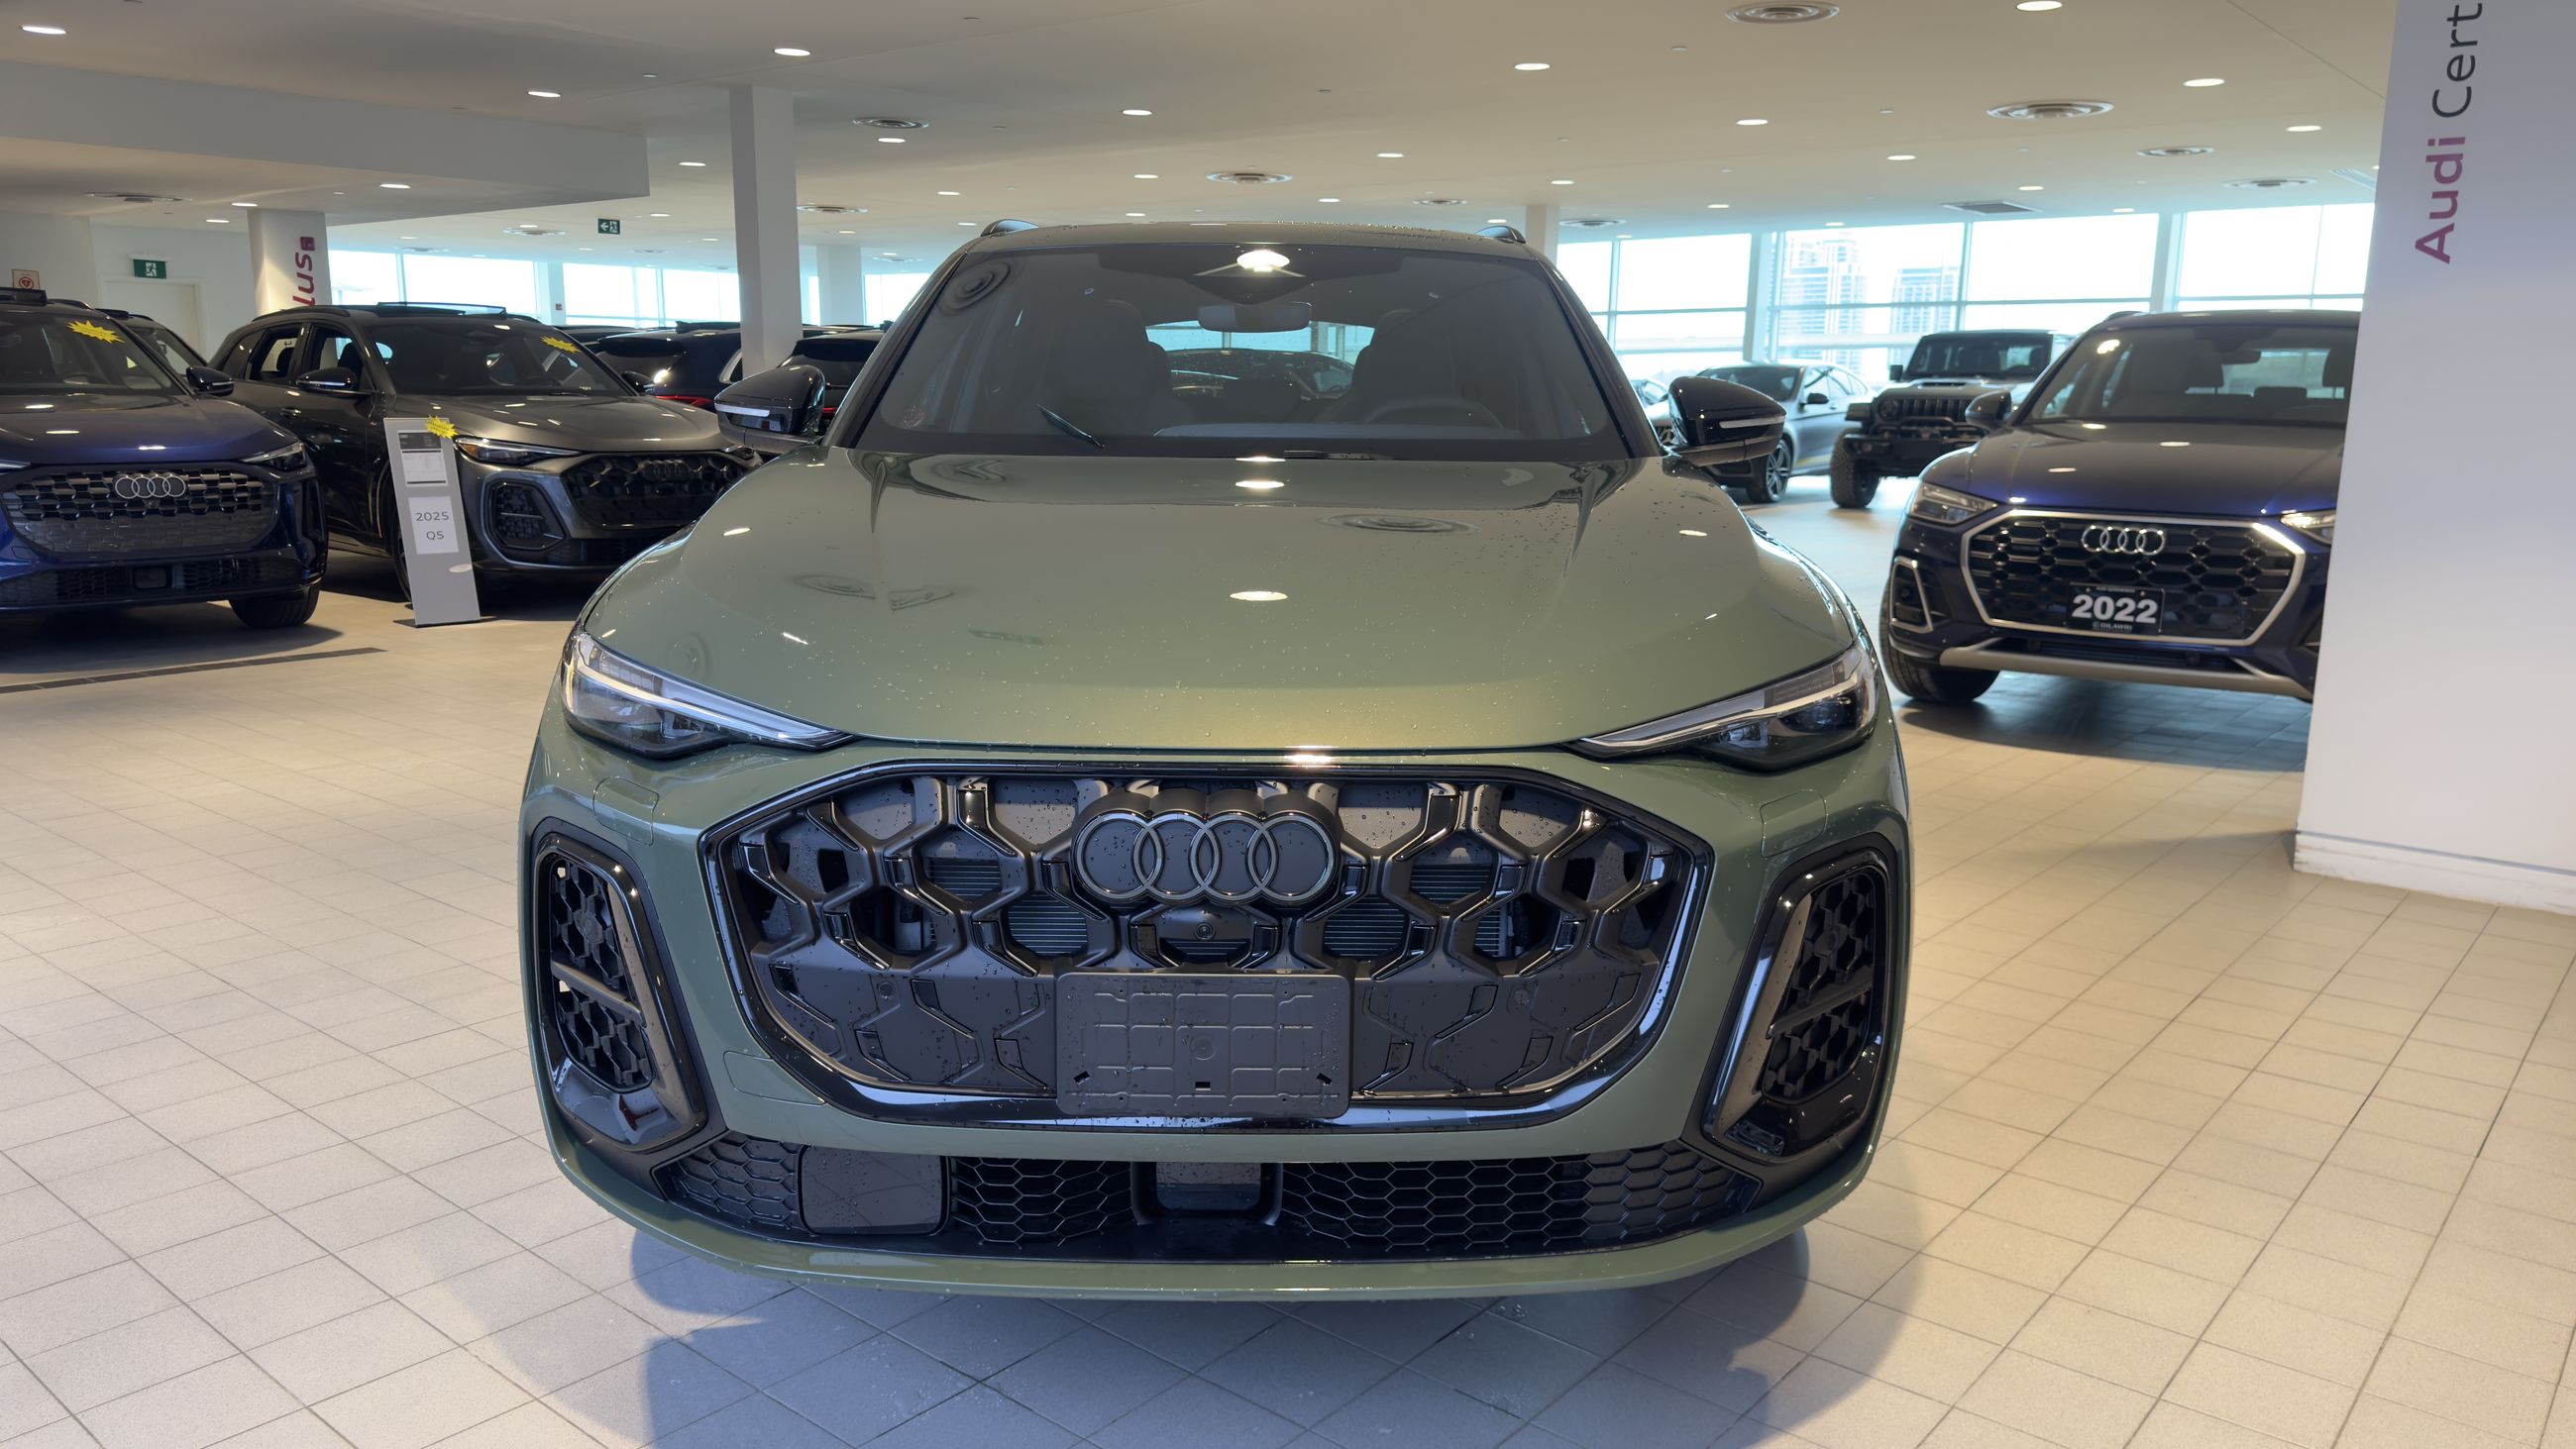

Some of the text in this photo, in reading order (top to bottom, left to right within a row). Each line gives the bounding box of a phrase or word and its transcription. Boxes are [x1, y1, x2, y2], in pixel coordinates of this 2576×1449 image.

[2415, 2, 2483, 264] Audi Cert
[292, 252, 315, 306] lus
[415, 511, 450, 521] 2025
[426, 531, 444, 540] Q5
[2072, 594, 2158, 624] 2022
